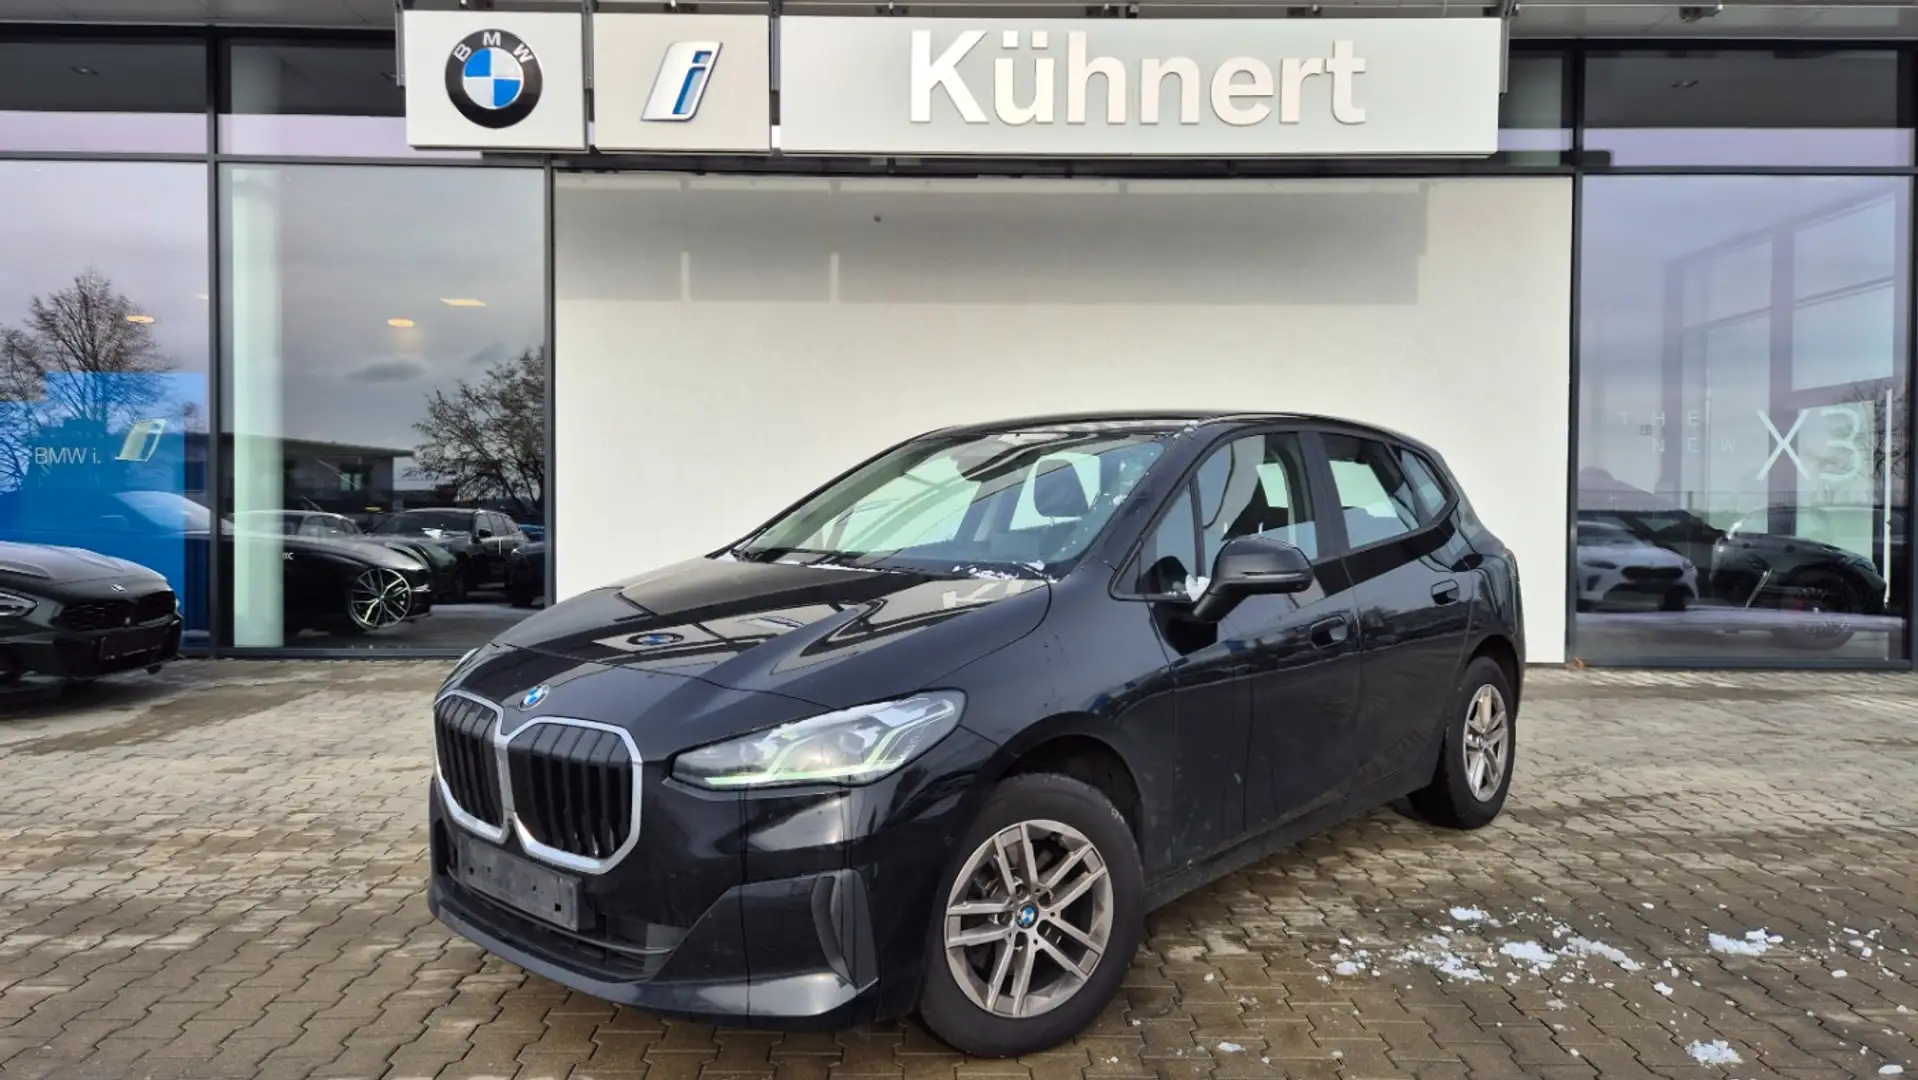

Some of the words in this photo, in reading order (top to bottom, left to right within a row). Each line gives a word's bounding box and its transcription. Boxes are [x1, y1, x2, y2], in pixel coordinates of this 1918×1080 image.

[452, 31, 534, 63] BMW
[910, 29, 1367, 126] Kühnert
[34, 447, 87, 464] BMW
[1652, 437, 1736, 453] NEW
[1756, 407, 1862, 481] X3
